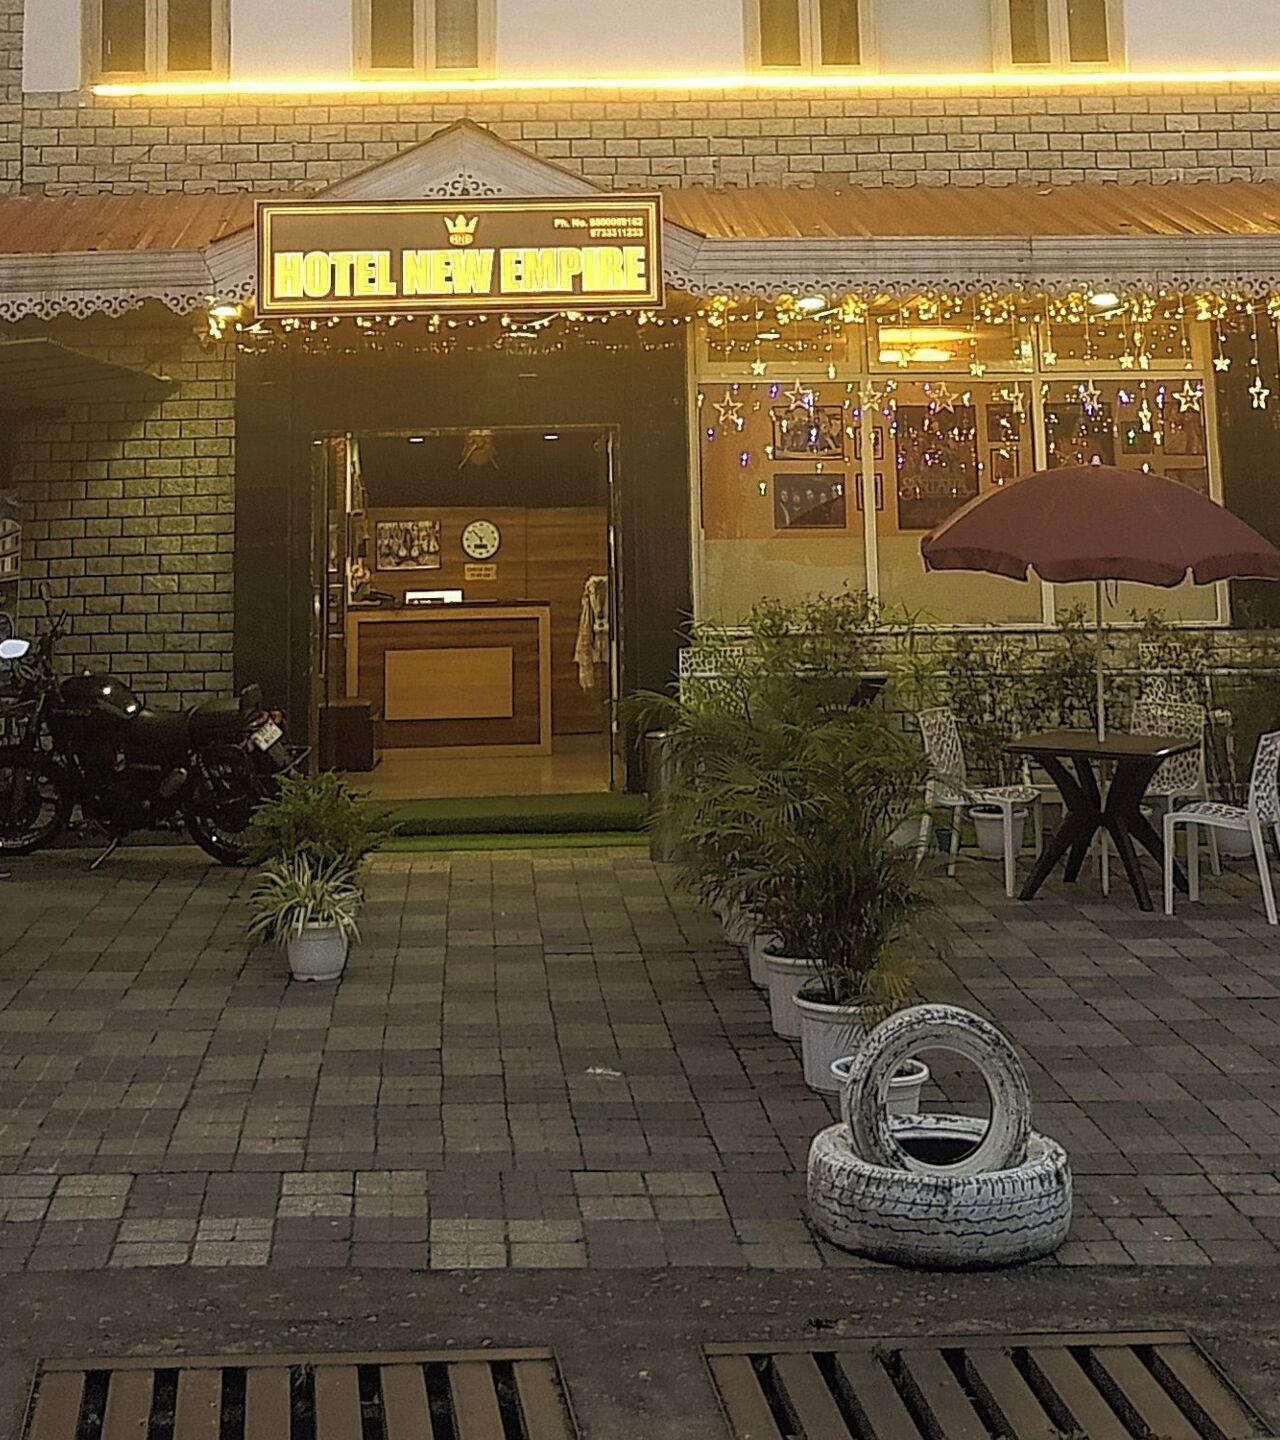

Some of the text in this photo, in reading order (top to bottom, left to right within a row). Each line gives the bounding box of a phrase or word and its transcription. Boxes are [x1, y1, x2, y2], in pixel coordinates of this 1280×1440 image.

[274, 246, 647, 297] HOTEL NEW EMPIRE
